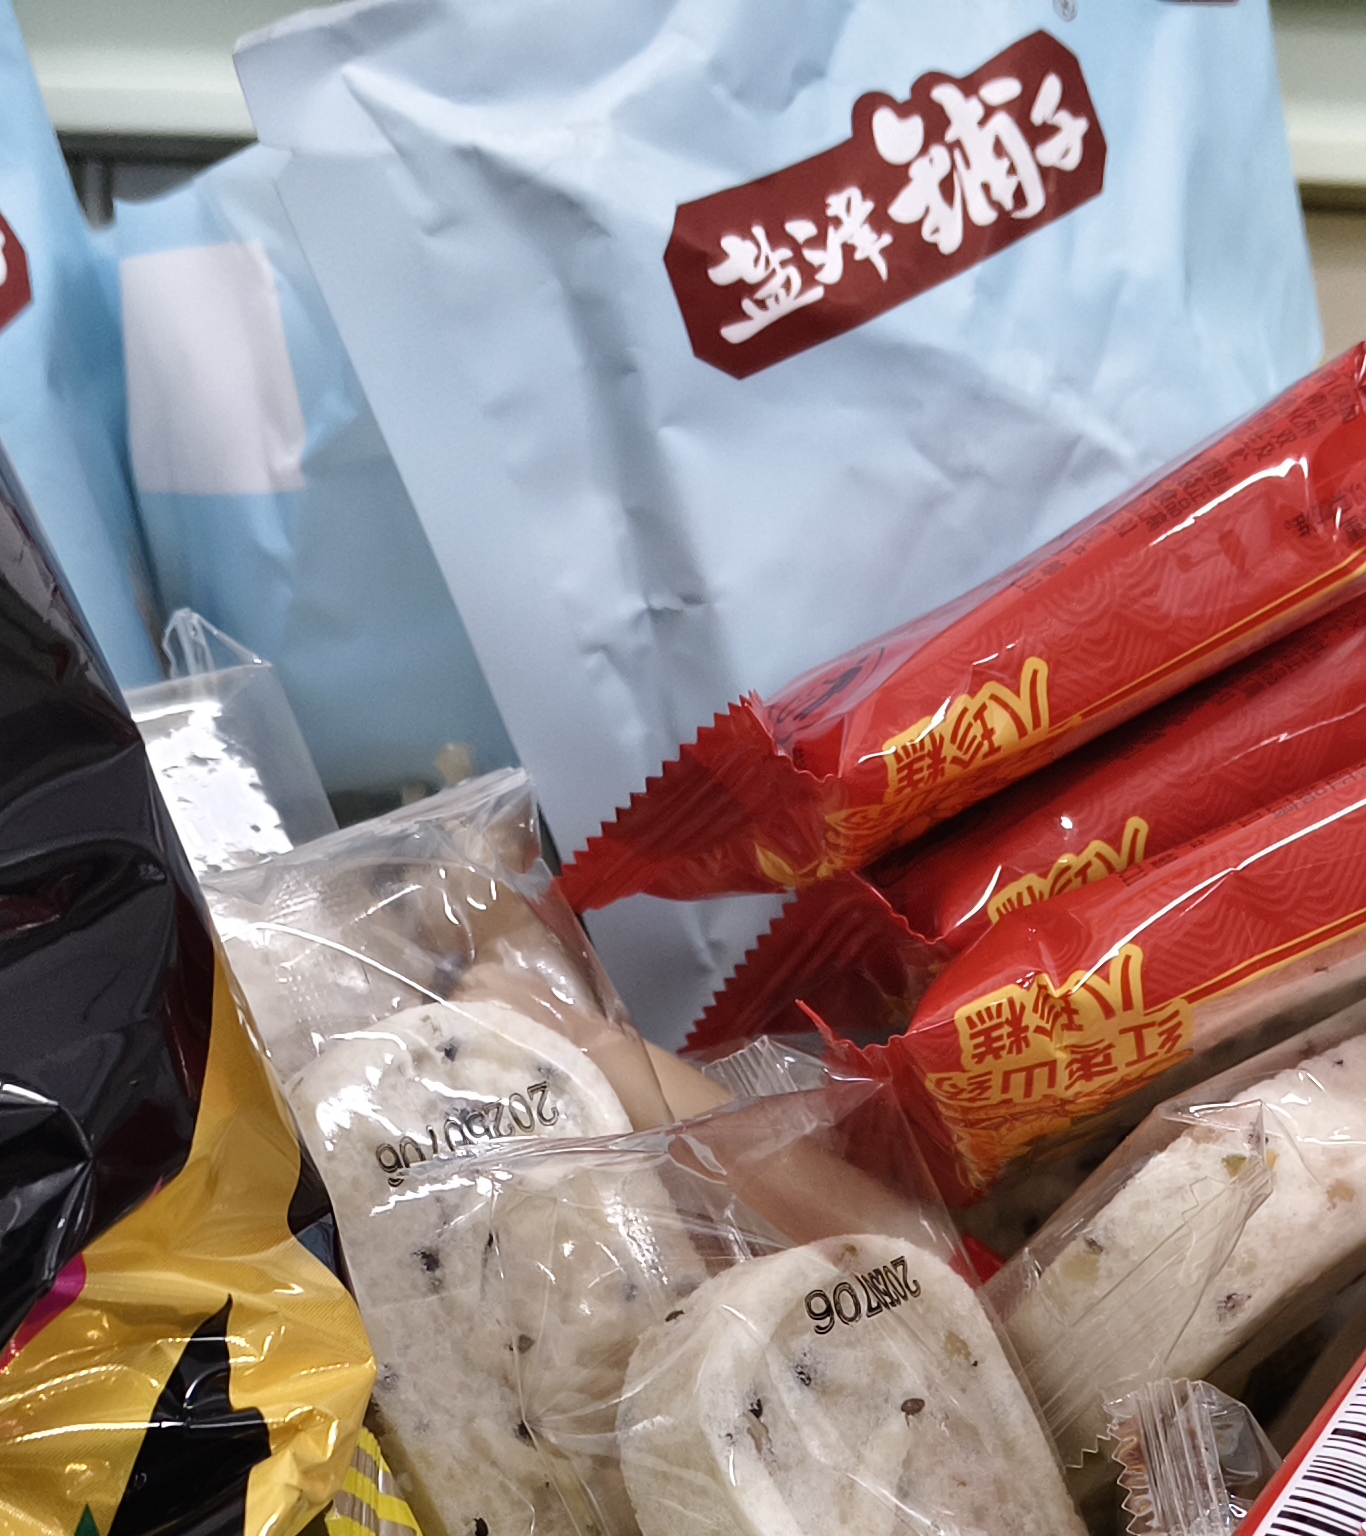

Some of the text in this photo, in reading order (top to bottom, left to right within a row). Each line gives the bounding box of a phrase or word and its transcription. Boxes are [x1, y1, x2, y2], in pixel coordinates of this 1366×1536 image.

[707, 72, 1090, 344] 盐津铺子
[932, 1009, 1183, 1091] 红枣山药
